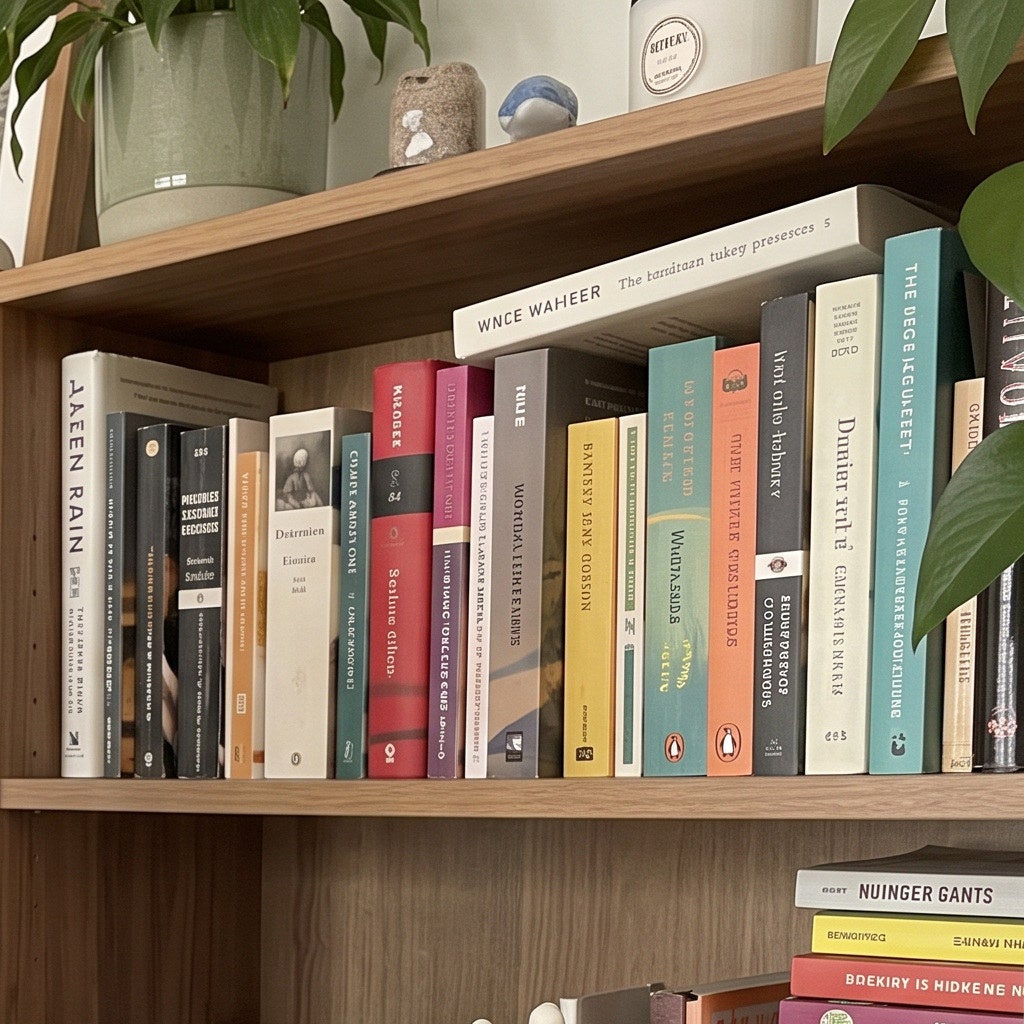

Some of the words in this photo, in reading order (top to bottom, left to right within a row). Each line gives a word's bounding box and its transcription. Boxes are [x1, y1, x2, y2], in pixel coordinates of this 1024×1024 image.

[904, 263, 918, 300] THE
[477, 308, 524, 334] WNCE
[529, 284, 602, 318] WAHEER
[618, 274, 643, 291] The
[69, 486, 84, 554] RAIN
[859, 884, 933, 902] NUINGER
[938, 886, 994, 904] GANTS
[915, 978, 929, 990] IS
